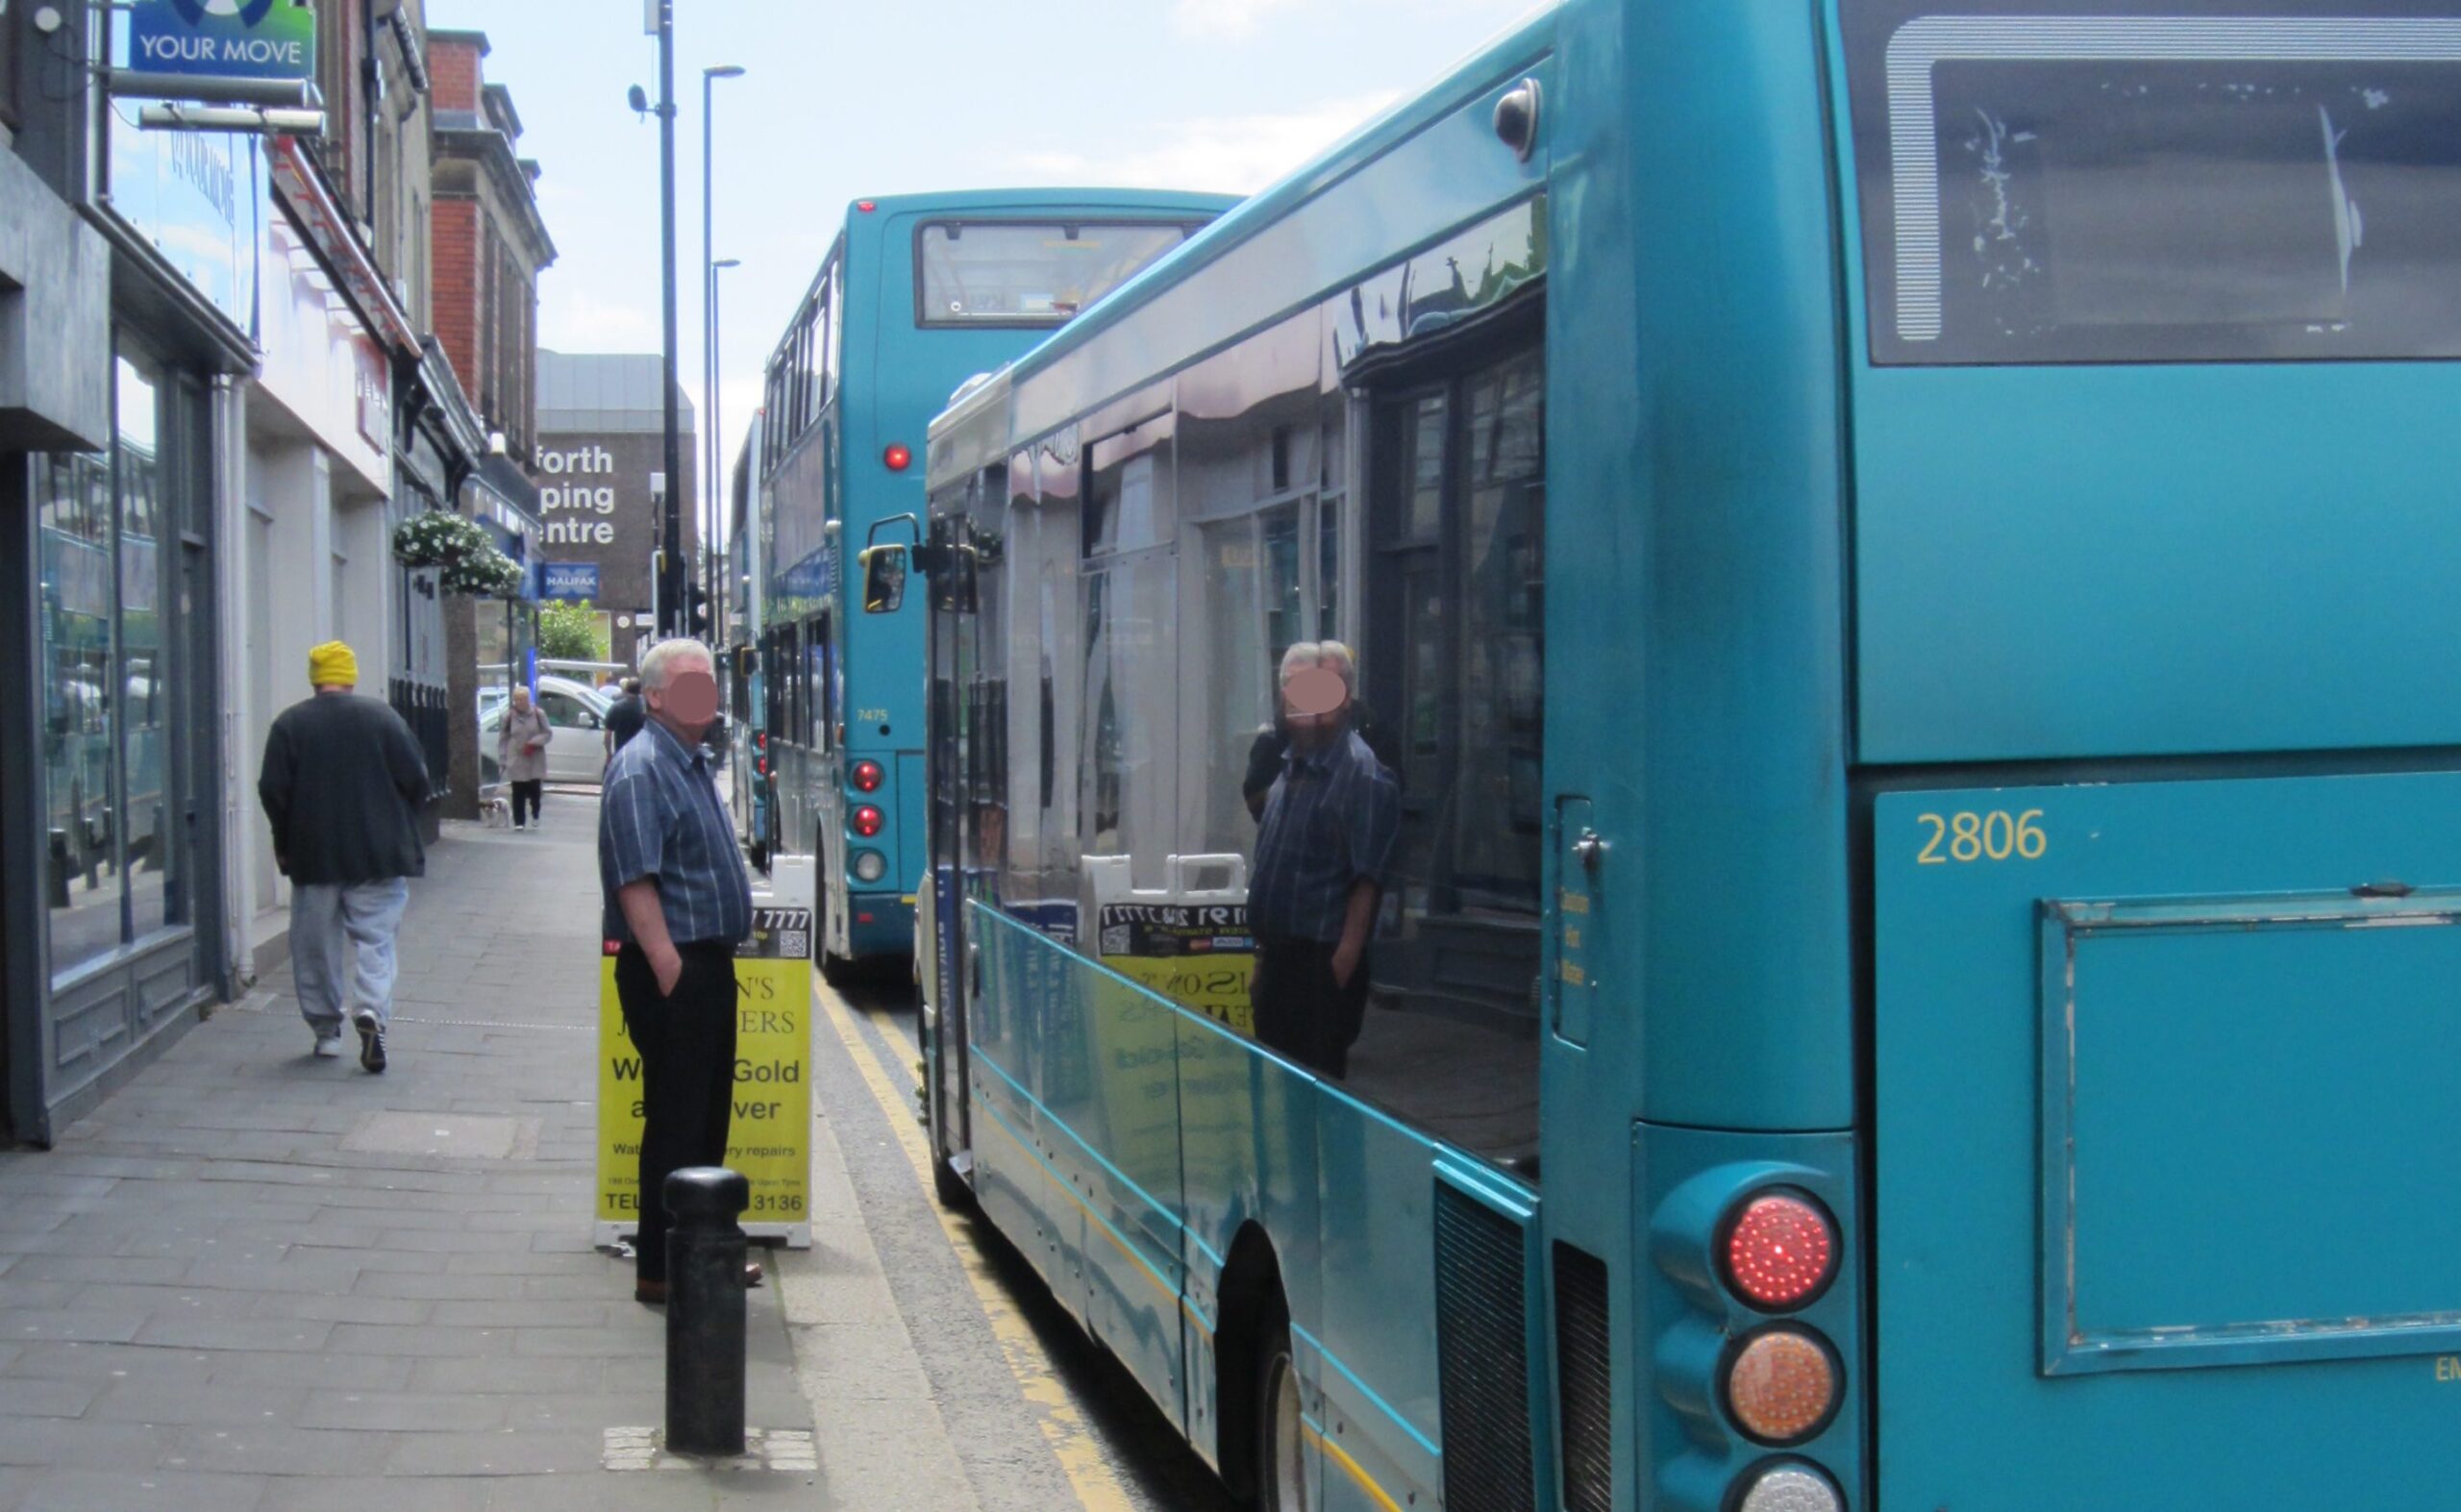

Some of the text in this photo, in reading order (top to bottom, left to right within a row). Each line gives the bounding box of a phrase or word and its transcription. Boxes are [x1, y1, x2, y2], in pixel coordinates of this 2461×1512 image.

[139, 35, 302, 64] YOUR MOVE
[535, 445, 613, 474] forth
[540, 482, 615, 514] ping
[539, 517, 615, 545] ntre
[546, 576, 597, 587] HALIFAX
[857, 707, 888, 722] 7475
[1917, 809, 2048, 864] 2806
[733, 1058, 800, 1083] Gold
[746, 1144, 796, 1159] repairs
[754, 1194, 803, 1211] 3136
